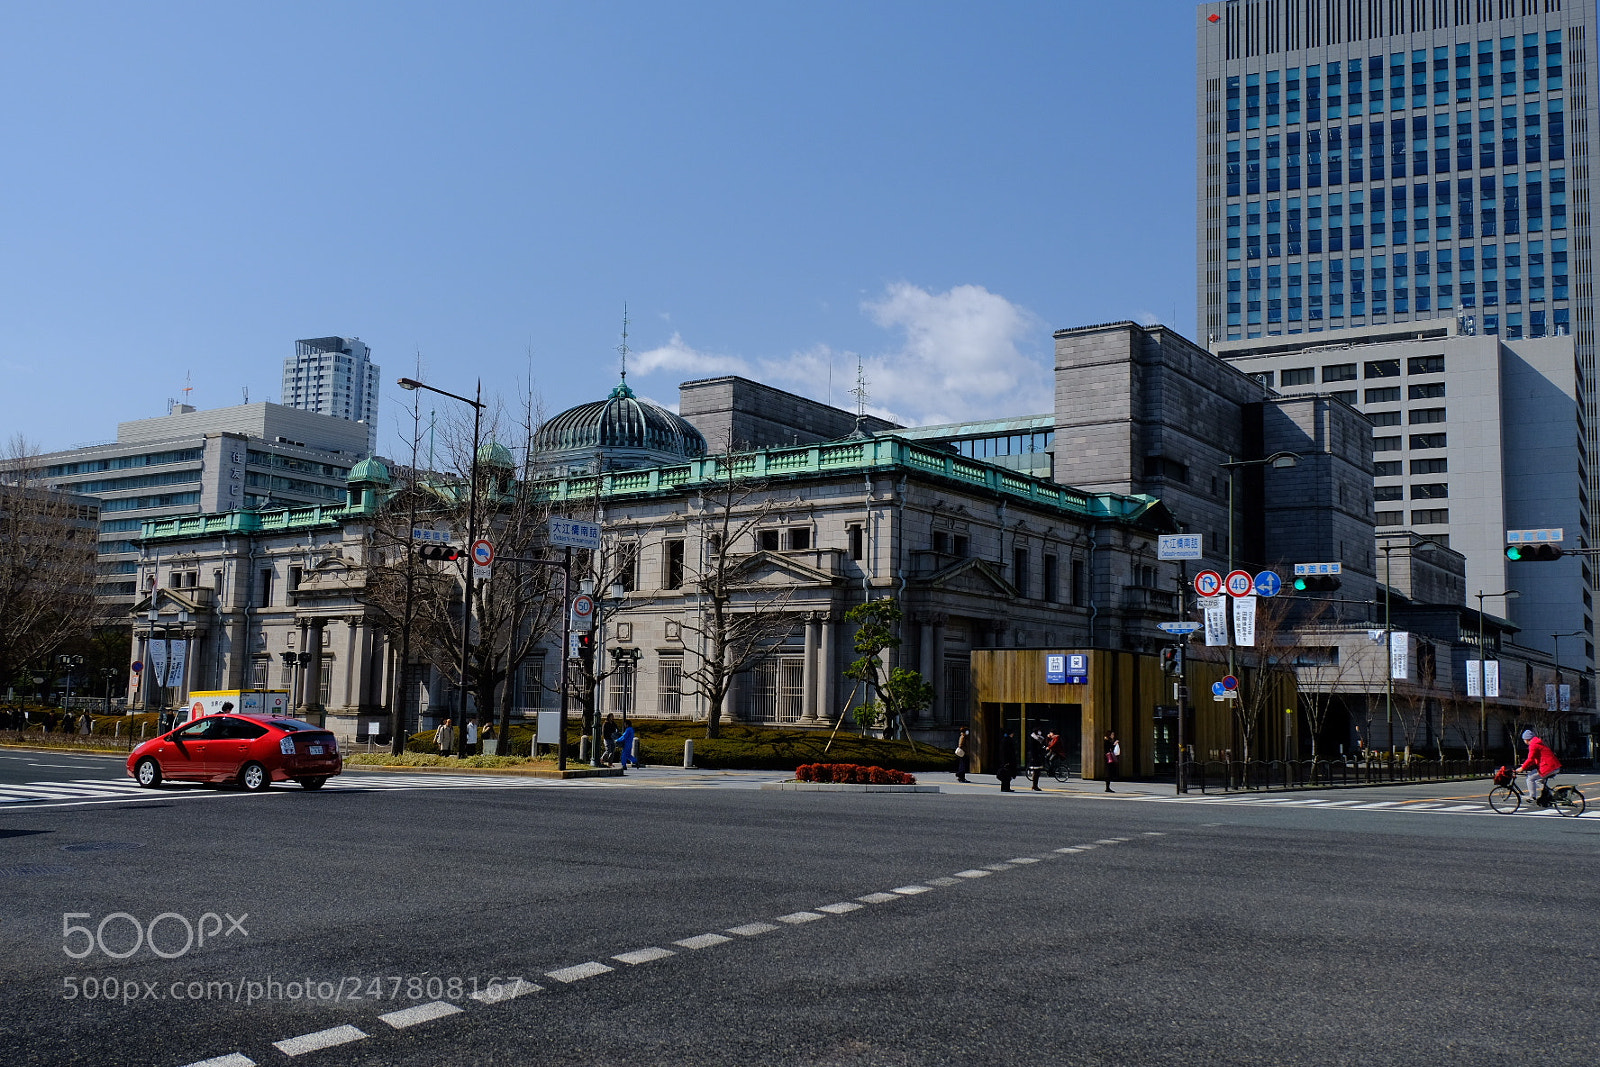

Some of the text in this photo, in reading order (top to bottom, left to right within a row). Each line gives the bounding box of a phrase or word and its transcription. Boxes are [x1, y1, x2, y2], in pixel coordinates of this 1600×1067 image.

[553, 522, 598, 539] 大江橋南詰
[1162, 537, 1198, 549] 大江橋南詰
[1231, 578, 1247, 590] 40
[578, 601, 589, 611] 50
